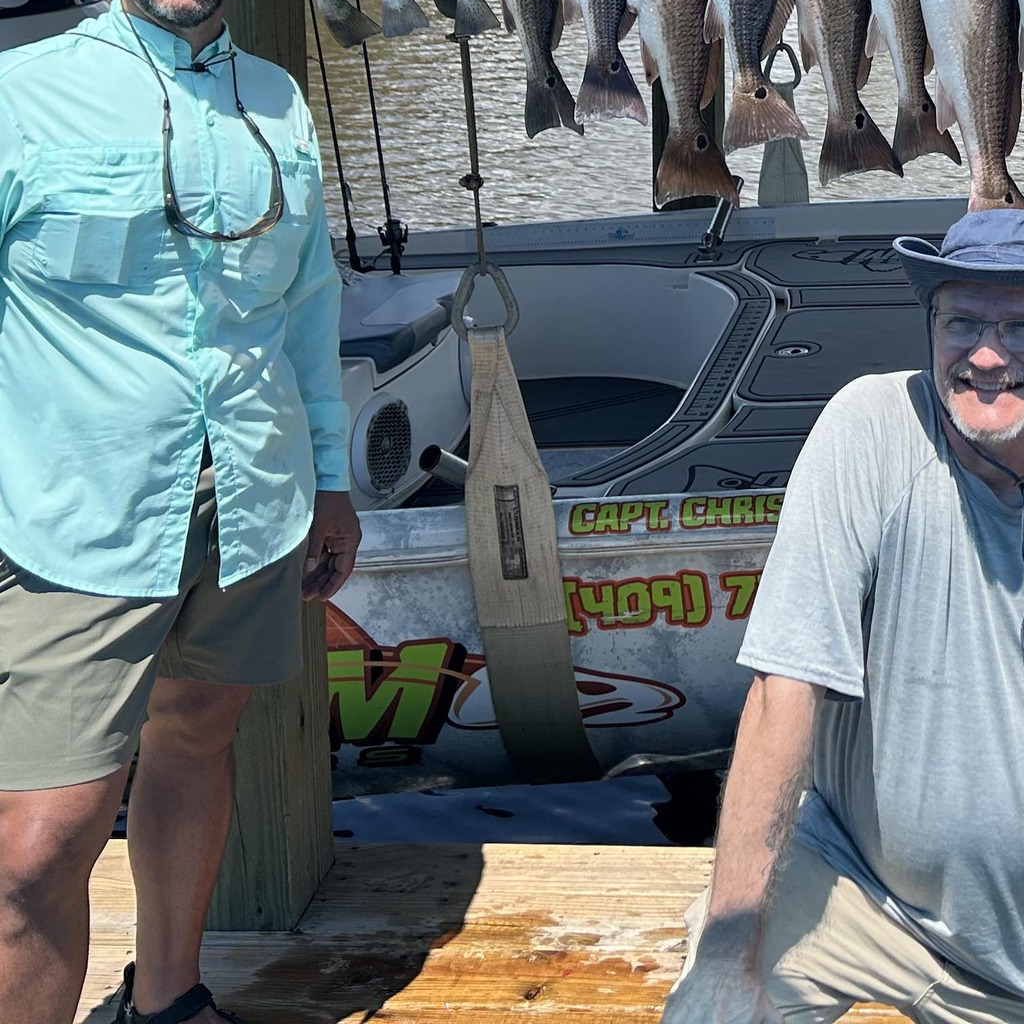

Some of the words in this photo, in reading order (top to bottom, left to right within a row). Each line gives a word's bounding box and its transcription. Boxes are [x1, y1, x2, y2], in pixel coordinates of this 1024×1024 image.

[569, 499, 673, 536] CAPT.
[679, 493, 786, 530] CHRIS
[562, 569, 712, 637] (409)
